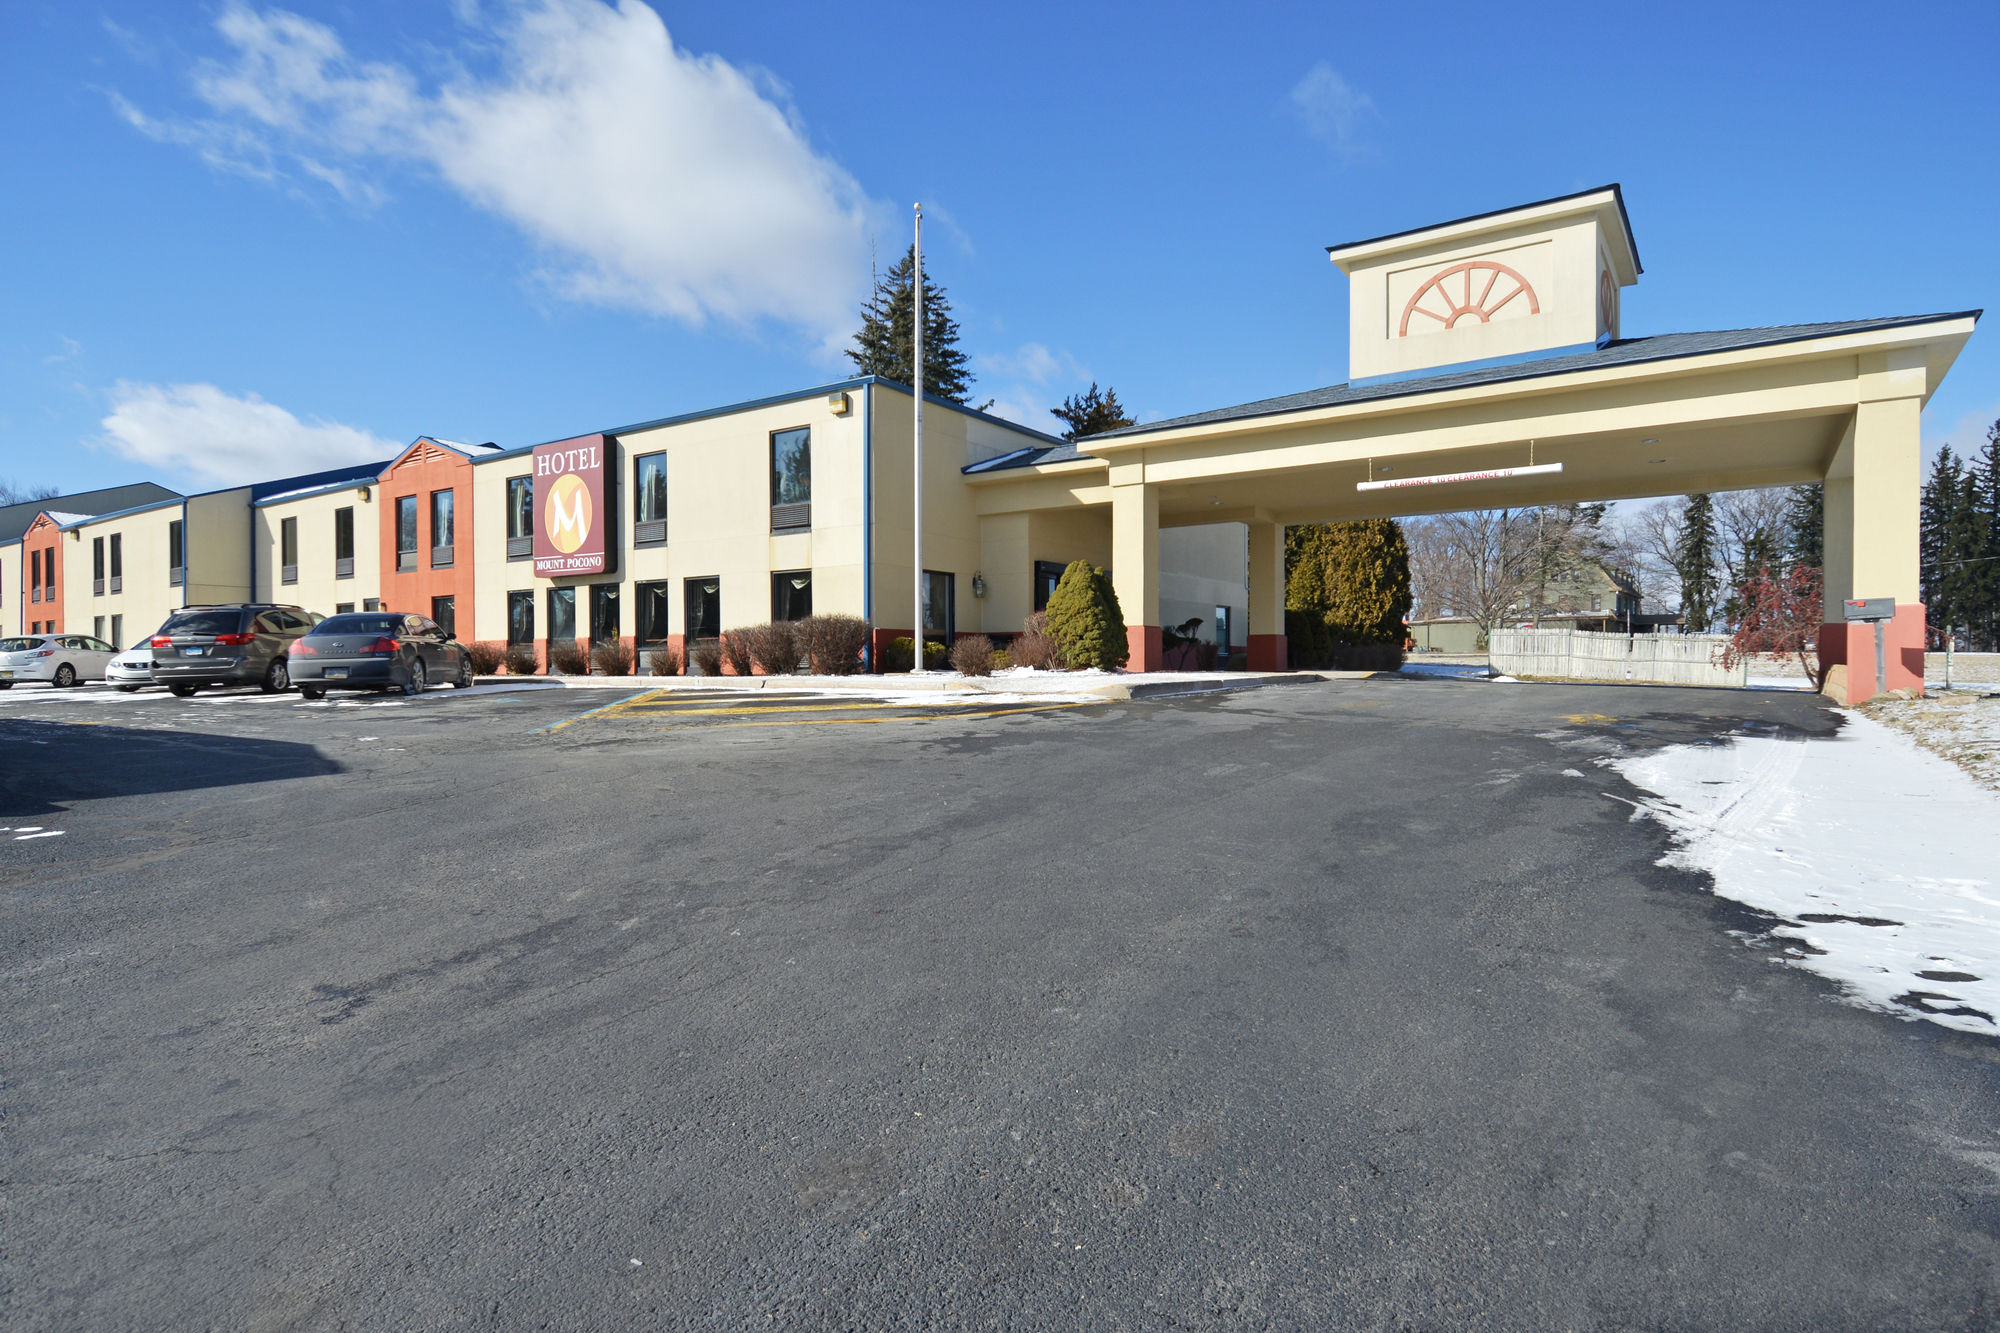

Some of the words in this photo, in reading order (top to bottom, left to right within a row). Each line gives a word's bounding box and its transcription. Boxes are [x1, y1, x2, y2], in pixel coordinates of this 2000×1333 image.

[537, 447, 600, 476] HOTEL
[1384, 478, 1433, 489] CLEARANCE
[1447, 470, 1499, 482] CLEARANCE
[553, 488, 588, 545] M
[536, 558, 564, 571] MOUNT
[567, 556, 602, 569] POCONO
